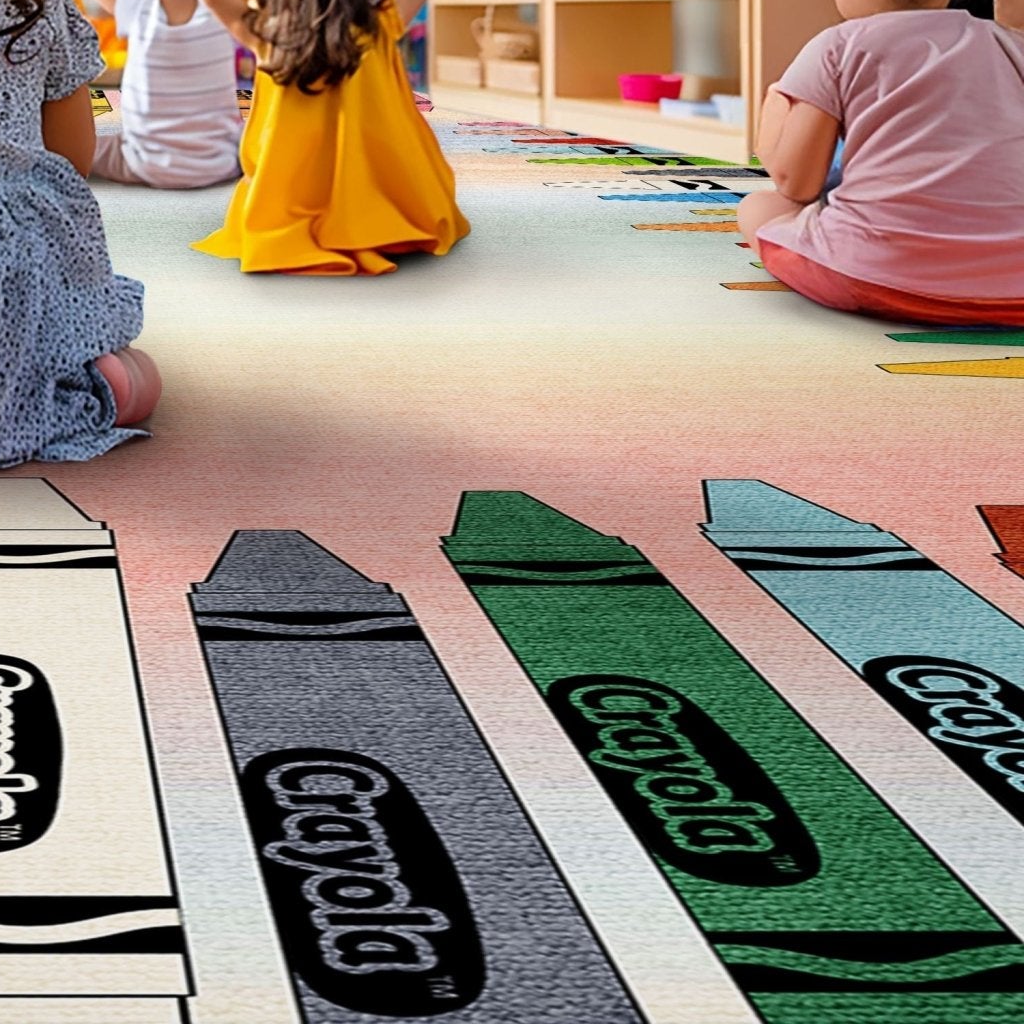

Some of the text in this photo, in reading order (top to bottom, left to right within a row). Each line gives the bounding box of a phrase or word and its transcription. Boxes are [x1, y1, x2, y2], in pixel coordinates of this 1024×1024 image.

[568, 685, 775, 854] Crayola
[886, 664, 1024, 793] Cray
[262, 761, 451, 974] Crayola
